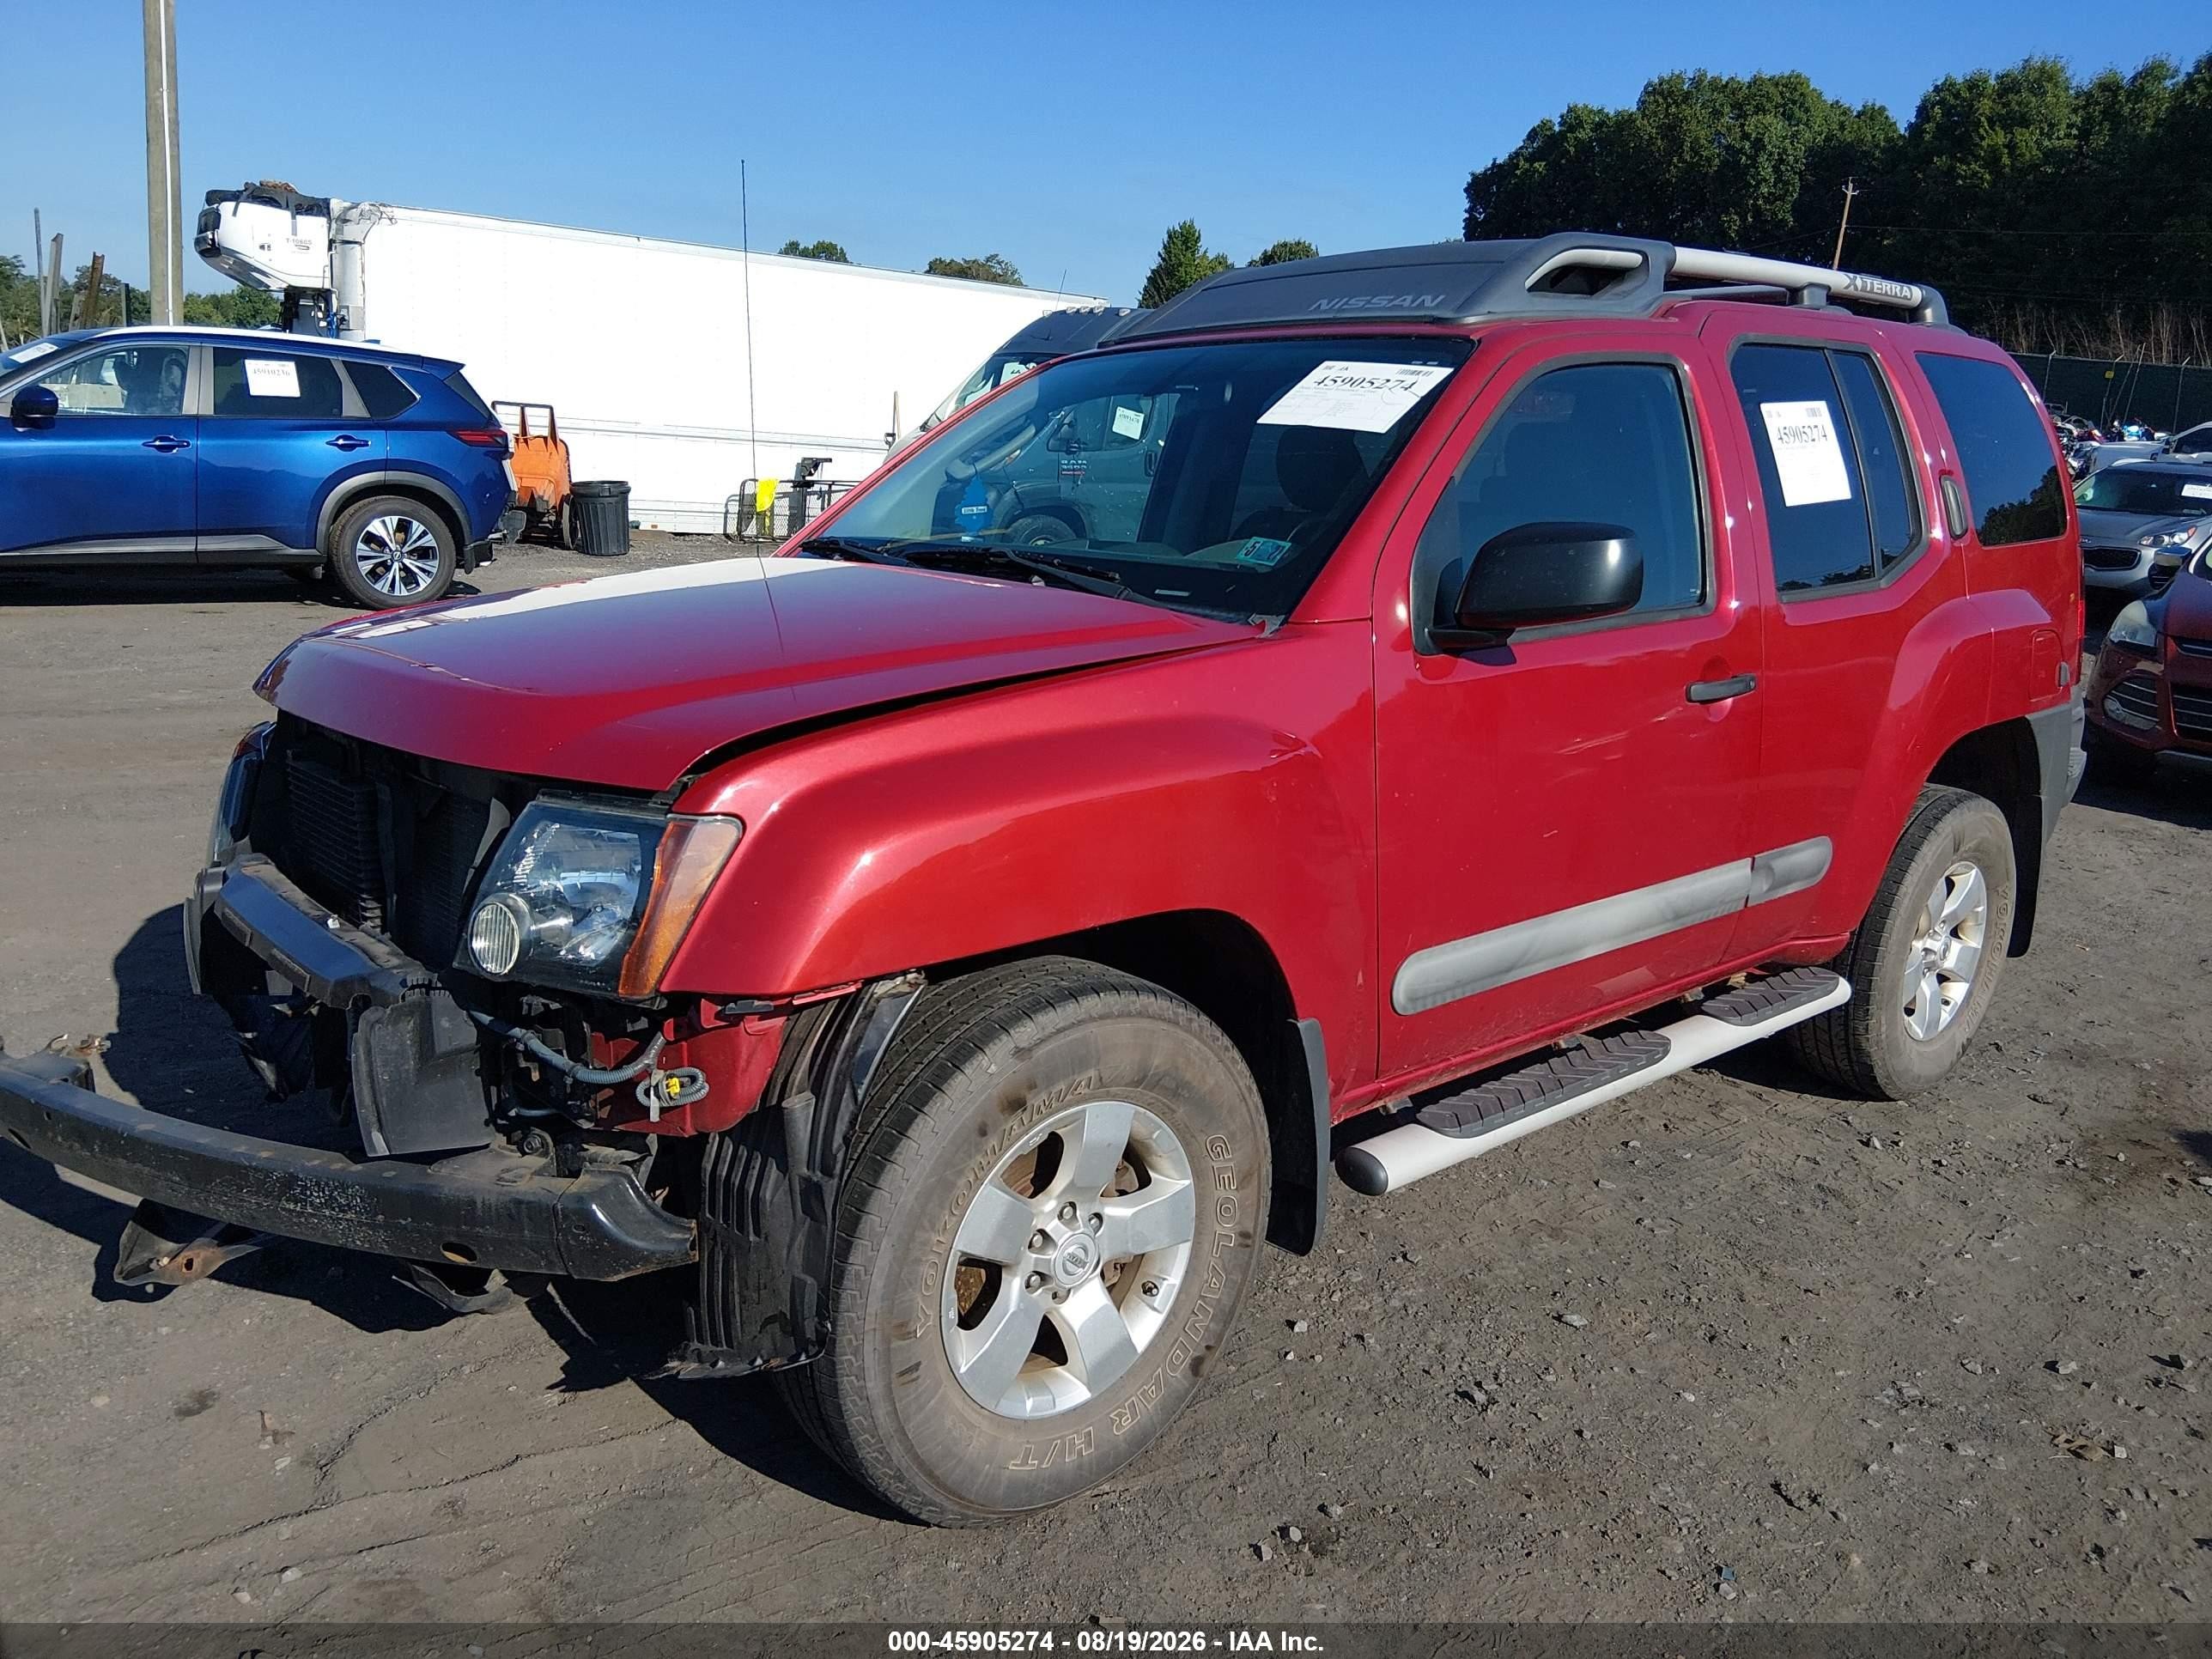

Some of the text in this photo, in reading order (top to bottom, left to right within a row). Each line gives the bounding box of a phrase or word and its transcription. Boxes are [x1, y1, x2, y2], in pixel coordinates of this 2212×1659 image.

[1844, 274, 1912, 300] XTERRA
[1308, 295, 1446, 311] NISSAN
[1314, 374, 1418, 392] 45905274
[1778, 424, 1827, 444] 45905274
[915, 1075, 1093, 1338] YOKOHAMA
[1110, 1134, 1238, 1436] GEOLANDAR
[1008, 1426, 1094, 1470] H/T
